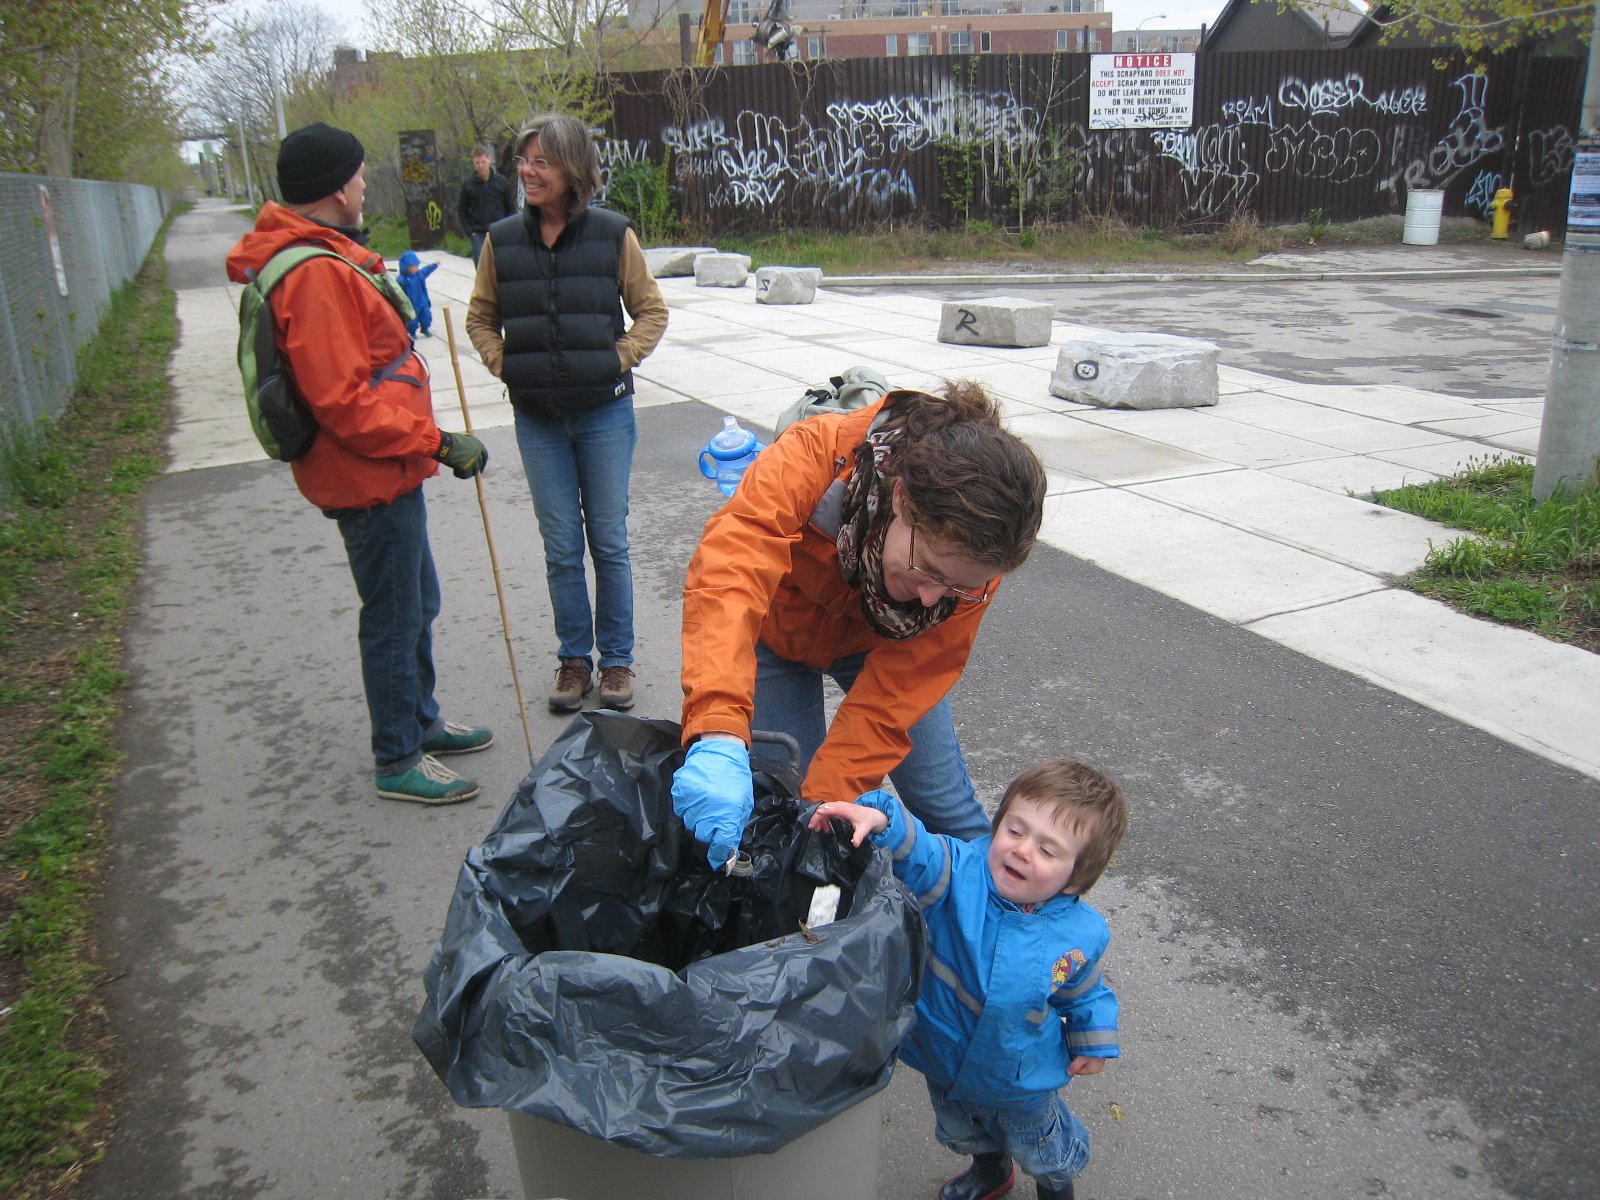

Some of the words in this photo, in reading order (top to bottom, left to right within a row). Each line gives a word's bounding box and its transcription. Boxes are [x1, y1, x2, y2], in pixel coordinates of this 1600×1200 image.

[1115, 56, 1170, 67] NOTICE
[1091, 80, 1115, 88] ACCEPT
[1163, 78, 1193, 86] VEHICLES!
[1109, 89, 1120, 97] NOT
[1144, 88, 1155, 96] ANY
[1158, 88, 1186, 96] VEHICLES
[1137, 97, 1171, 105] BOULEVARD
[1122, 107, 1135, 115] WILL
[1171, 106, 1189, 114] AWAY.
[955, 308, 979, 336] R
